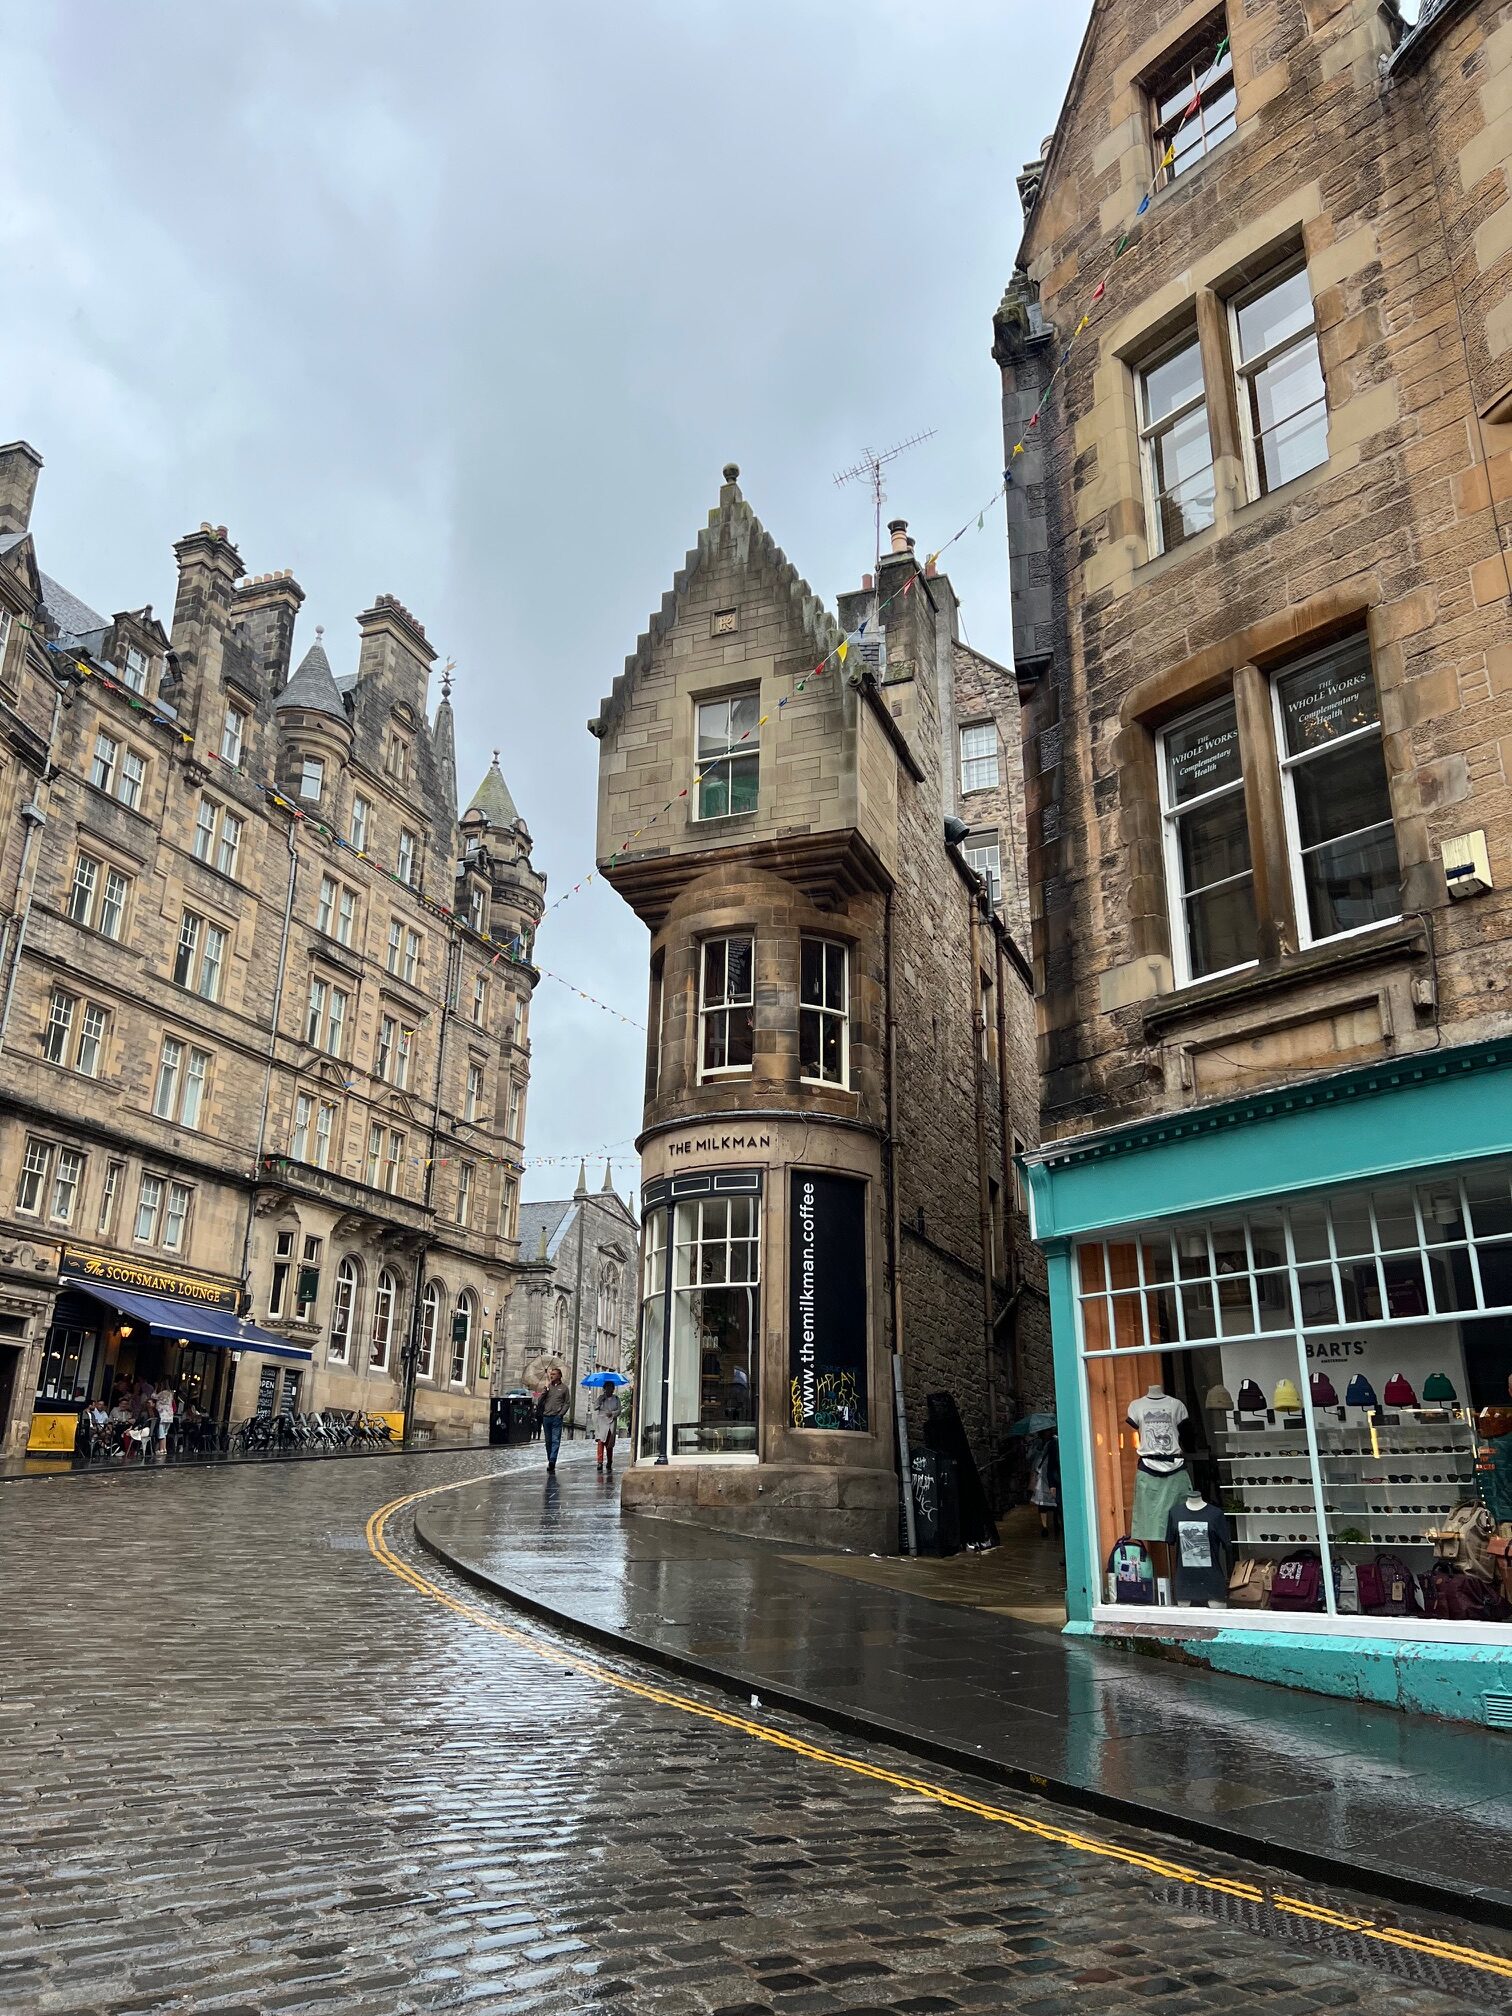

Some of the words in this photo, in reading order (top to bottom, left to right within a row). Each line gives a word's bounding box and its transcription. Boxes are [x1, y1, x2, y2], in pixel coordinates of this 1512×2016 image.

[1288, 690, 1326, 713] WHOLE
[1328, 673, 1367, 696] WORKS
[1318, 679, 1333, 690] THE
[1298, 693, 1360, 723] Complementary
[1316, 709, 1343, 726] Health
[1172, 745, 1204, 766] WHOLE
[1205, 729, 1238, 751] WORKS
[1197, 734, 1210, 745] THE
[1179, 749, 1232, 776] Complementary
[1194, 763, 1217, 779] Health
[668, 1141, 692, 1157] THE
[696, 1135, 771, 1152] MILKMAN
[83, 1260, 105, 1277] The
[105, 1266, 176, 1293] SCOTSMAN'S
[178, 1282, 221, 1303] LOUNGE
[800, 1181, 815, 1419] www.themilkman.coffee
[1305, 1340, 1364, 1359] BARTS
